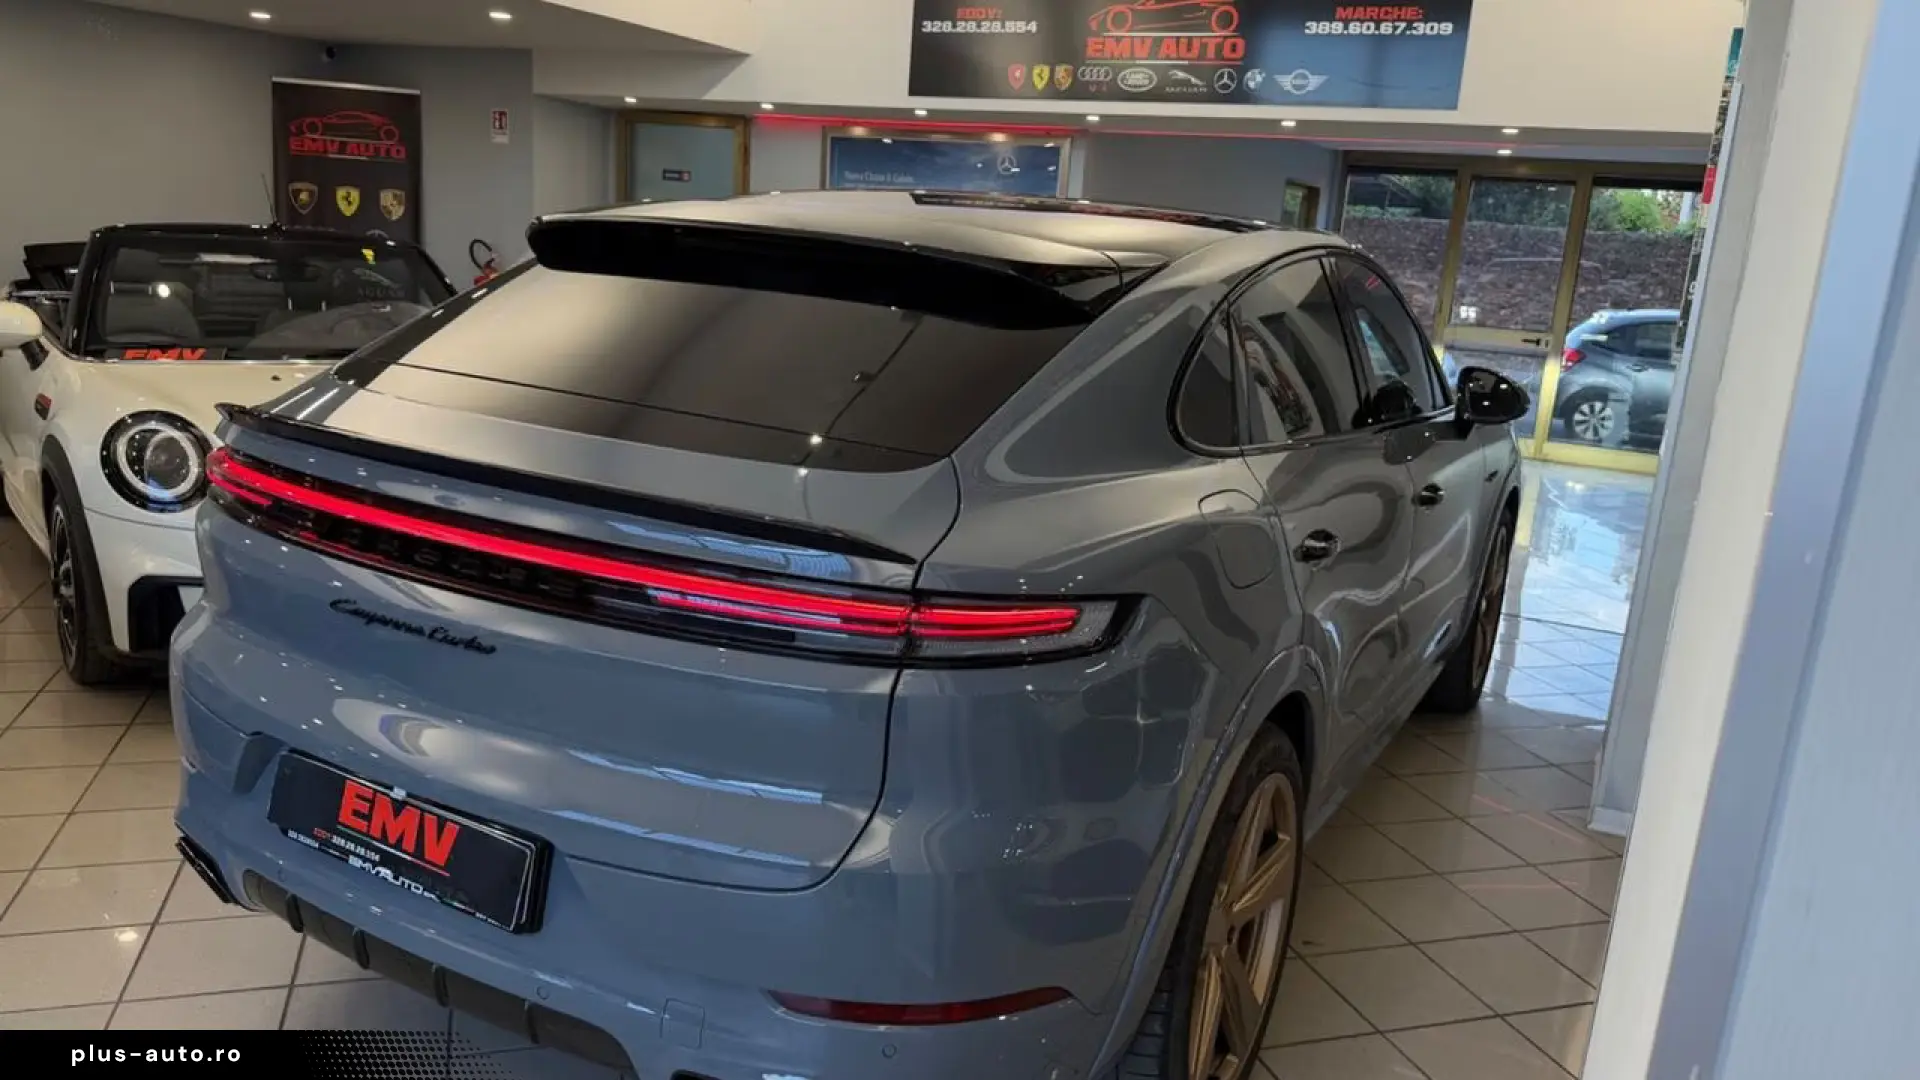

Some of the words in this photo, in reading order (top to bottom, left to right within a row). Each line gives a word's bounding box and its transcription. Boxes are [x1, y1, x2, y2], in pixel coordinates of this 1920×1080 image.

[1335, 6, 1424, 20] MARCHE:
[1304, 21, 1454, 35] 389.60.67.309
[1086, 37, 1152, 59] EMV
[1157, 38, 1245, 60] AUTO
[288, 135, 340, 156] EMV
[343, 141, 407, 160] AUTO
[337, 779, 460, 867] EMV
